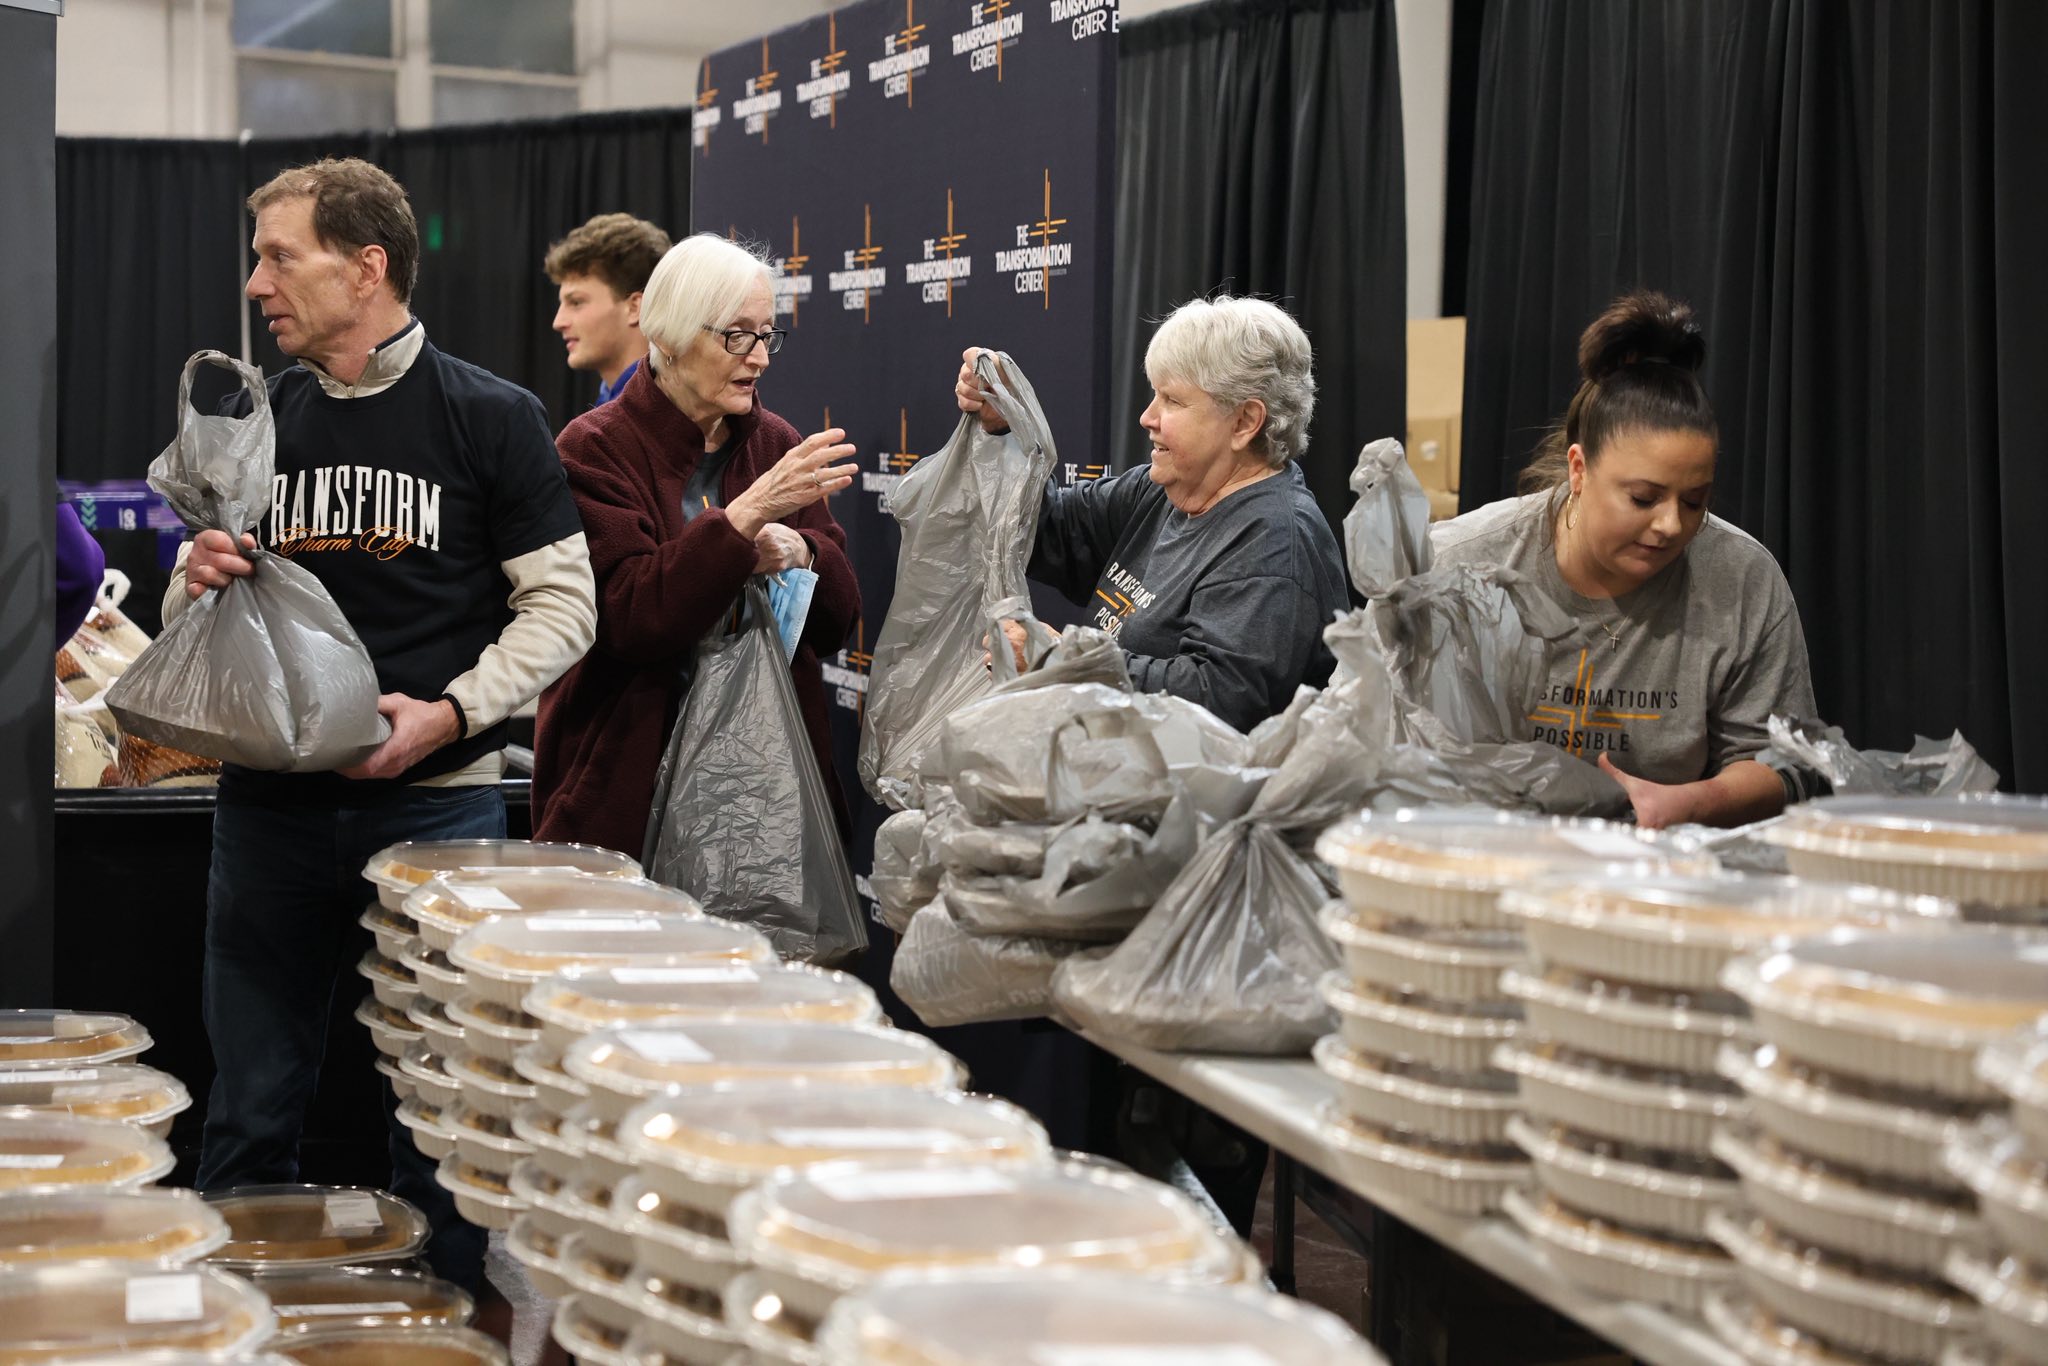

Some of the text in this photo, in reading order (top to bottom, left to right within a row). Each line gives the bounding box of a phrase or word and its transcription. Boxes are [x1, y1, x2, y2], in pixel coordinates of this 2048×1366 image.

[971, 3, 984, 26] THE
[1072, 9, 1107, 41] CENTER
[952, 12, 1023, 56] TRANSFORMATION
[970, 44, 998, 72] CENTER
[1016, 224, 1029, 247] THE
[905, 255, 972, 284] TRANSFORMATION
[995, 242, 1072, 273] TRANSFORMATION
[922, 280, 948, 304] CENTER
[1014, 269, 1045, 294] CENTER
[269, 464, 442, 552] RANSFORM
[273, 526, 419, 561] Charm City
[1533, 726, 1631, 752] POSSIBLE
